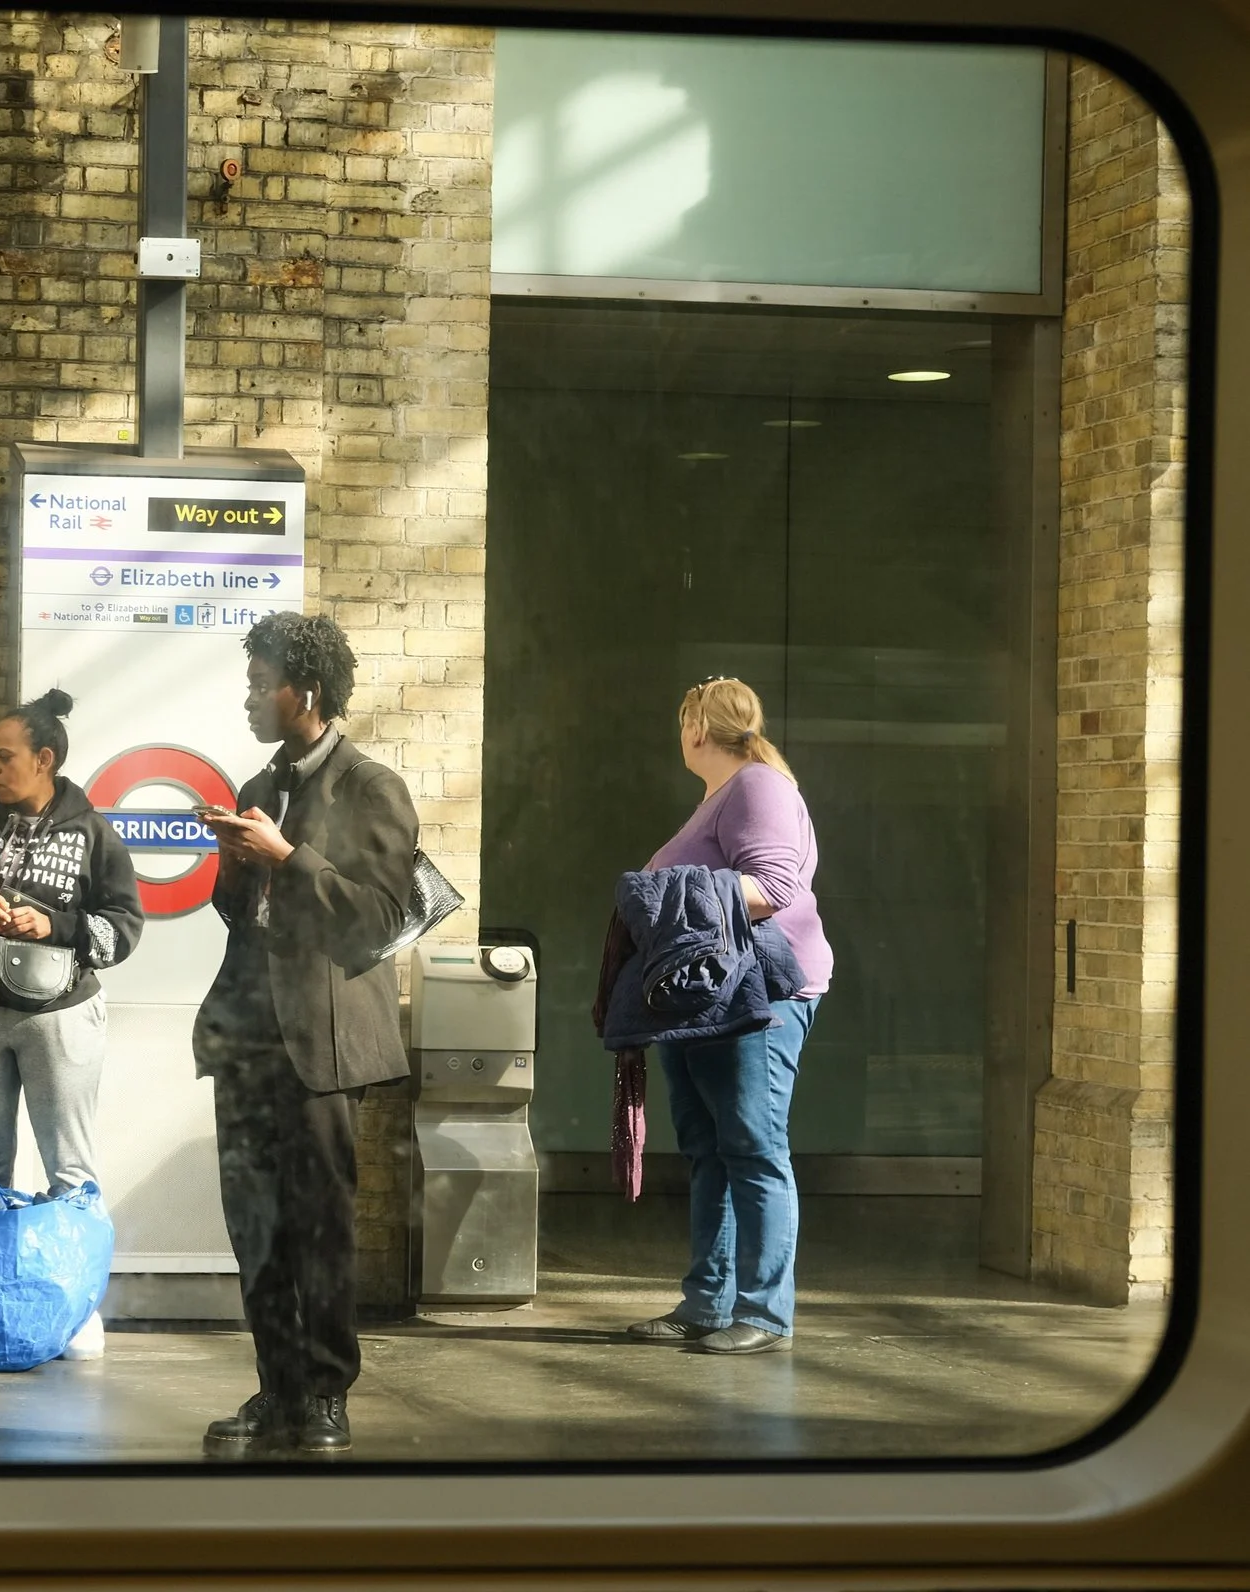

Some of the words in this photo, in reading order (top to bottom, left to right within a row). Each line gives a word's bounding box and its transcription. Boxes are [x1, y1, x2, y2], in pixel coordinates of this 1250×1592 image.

[50, 494, 126, 512] National
[50, 514, 82, 530] Rail
[175, 504, 217, 527] Way
[223, 508, 258, 524] out
[121, 568, 215, 588] Elizabeth
[223, 571, 258, 589] line
[53, 612, 92, 621] National
[95, 613, 111, 622] Rail
[114, 613, 130, 622] and
[139, 614, 150, 622] Way
[81, 603, 91, 611] to
[108, 603, 150, 613] Elizabeth
[152, 604, 169, 614] line
[222, 608, 258, 626] Lift
[112, 820, 217, 840] RRINGDO
[32, 853, 82, 875] WITH
[16, 868, 77, 891] OTHER
[515, 1057, 527, 1067] 95
